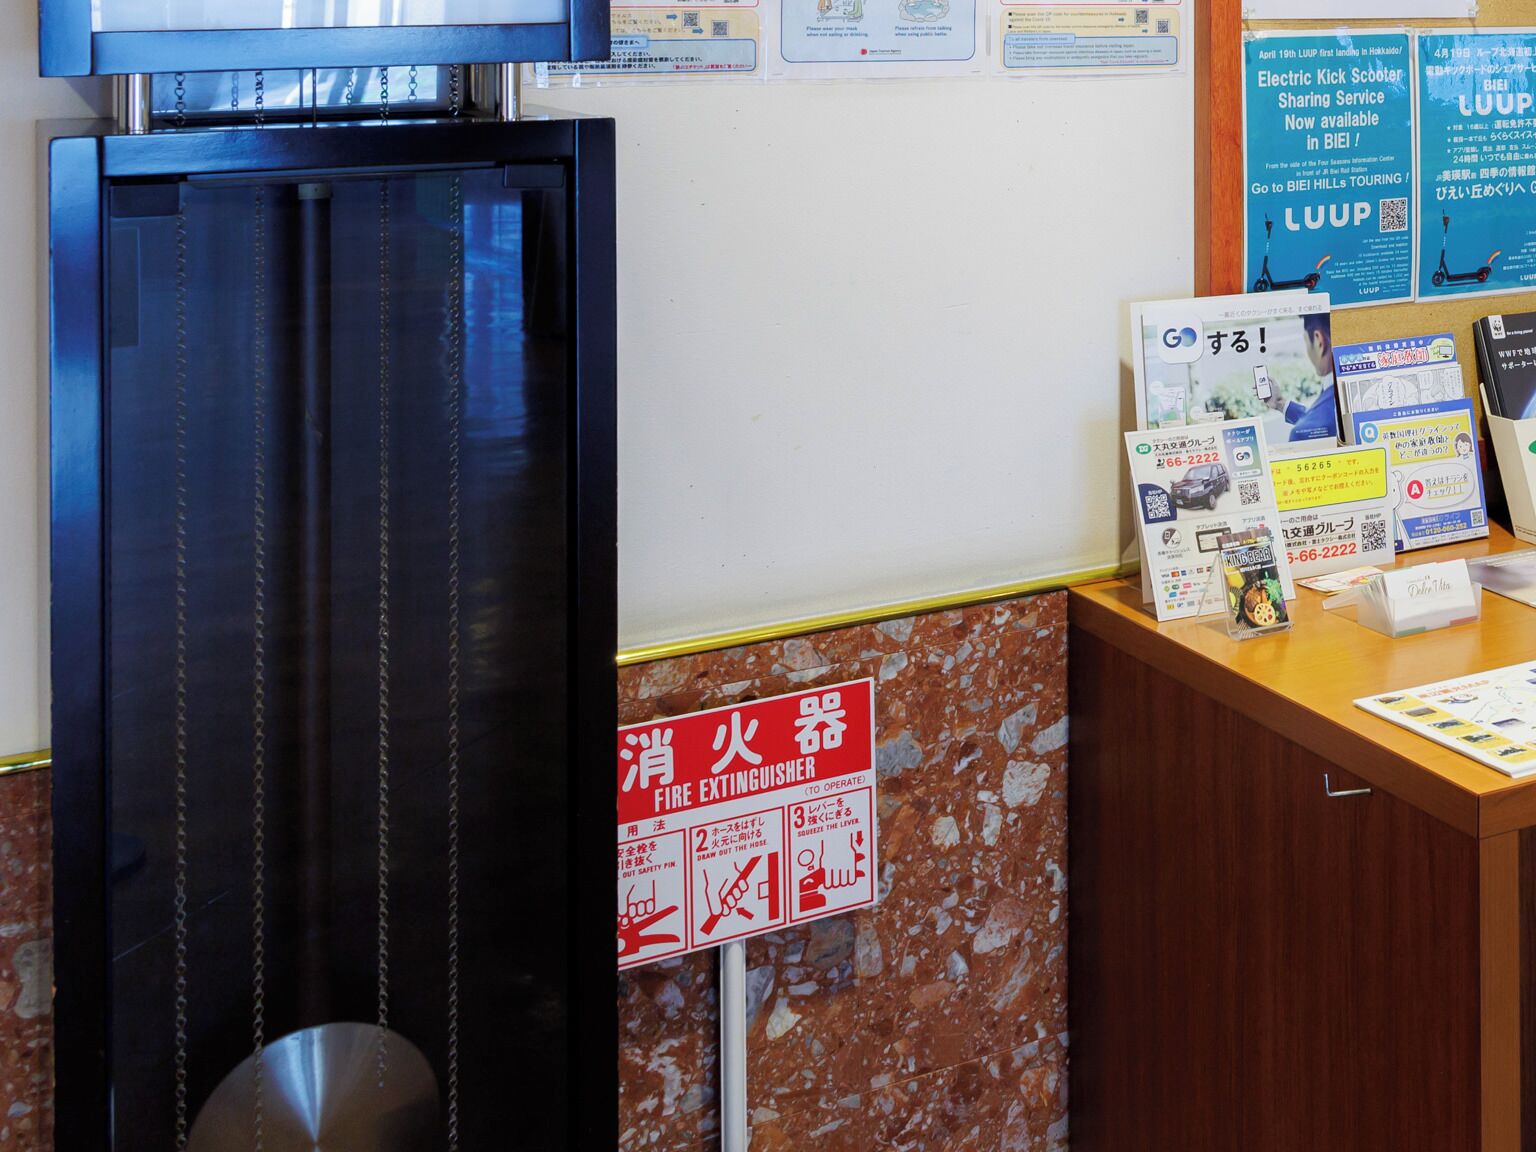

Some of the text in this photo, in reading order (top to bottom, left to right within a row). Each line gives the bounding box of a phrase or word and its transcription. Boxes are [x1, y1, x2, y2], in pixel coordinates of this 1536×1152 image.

[1259, 51, 1276, 59] April
[1279, 50, 1296, 58] 19th
[1299, 49, 1317, 57] LUUP
[1258, 68, 1401, 87] Electric Kick Scooter
[1484, 79, 1508, 91] BIEI
[1279, 90, 1384, 108] Sharing Service
[1459, 93, 1532, 116] LUUP
[1285, 111, 1379, 130] Now available
[1307, 136, 1318, 150] in
[1252, 183, 1268, 194] Go
[1272, 182, 1283, 193] to
[1287, 180, 1310, 192] BIEI
[1314, 178, 1346, 190] HILLs
[1350, 173, 1401, 187] TOURING
[1436, 184, 1525, 200] びえい丘めぐりへ
[1285, 202, 1371, 231] LUUP
[1163, 327, 1197, 348] GO
[1365, 427, 1374, 439] Q
[1166, 452, 1219, 467] 66-2222
[1297, 461, 1331, 472] 56265
[1411, 484, 1421, 495] A
[1227, 545, 1272, 567] KING BEAR
[620, 691, 847, 793] 消火器
[655, 757, 815, 812] FIRE EXTINGUISHER
[808, 798, 844, 815] レバーを
[794, 806, 805, 829] 3
[808, 808, 852, 826] 強くにぎる
[711, 817, 765, 837] ホースをはずし
[797, 827, 824, 838] SQUEEZE
[826, 824, 838, 832] THE
[695, 829, 708, 853] 2
[711, 829, 762, 849] 火元に向ける
[697, 851, 717, 862] DRAW
[719, 848, 733, 857] OUT
[735, 844, 748, 853] THE
[623, 869, 636, 878] OUT
[638, 865, 662, 875] SAFETY
